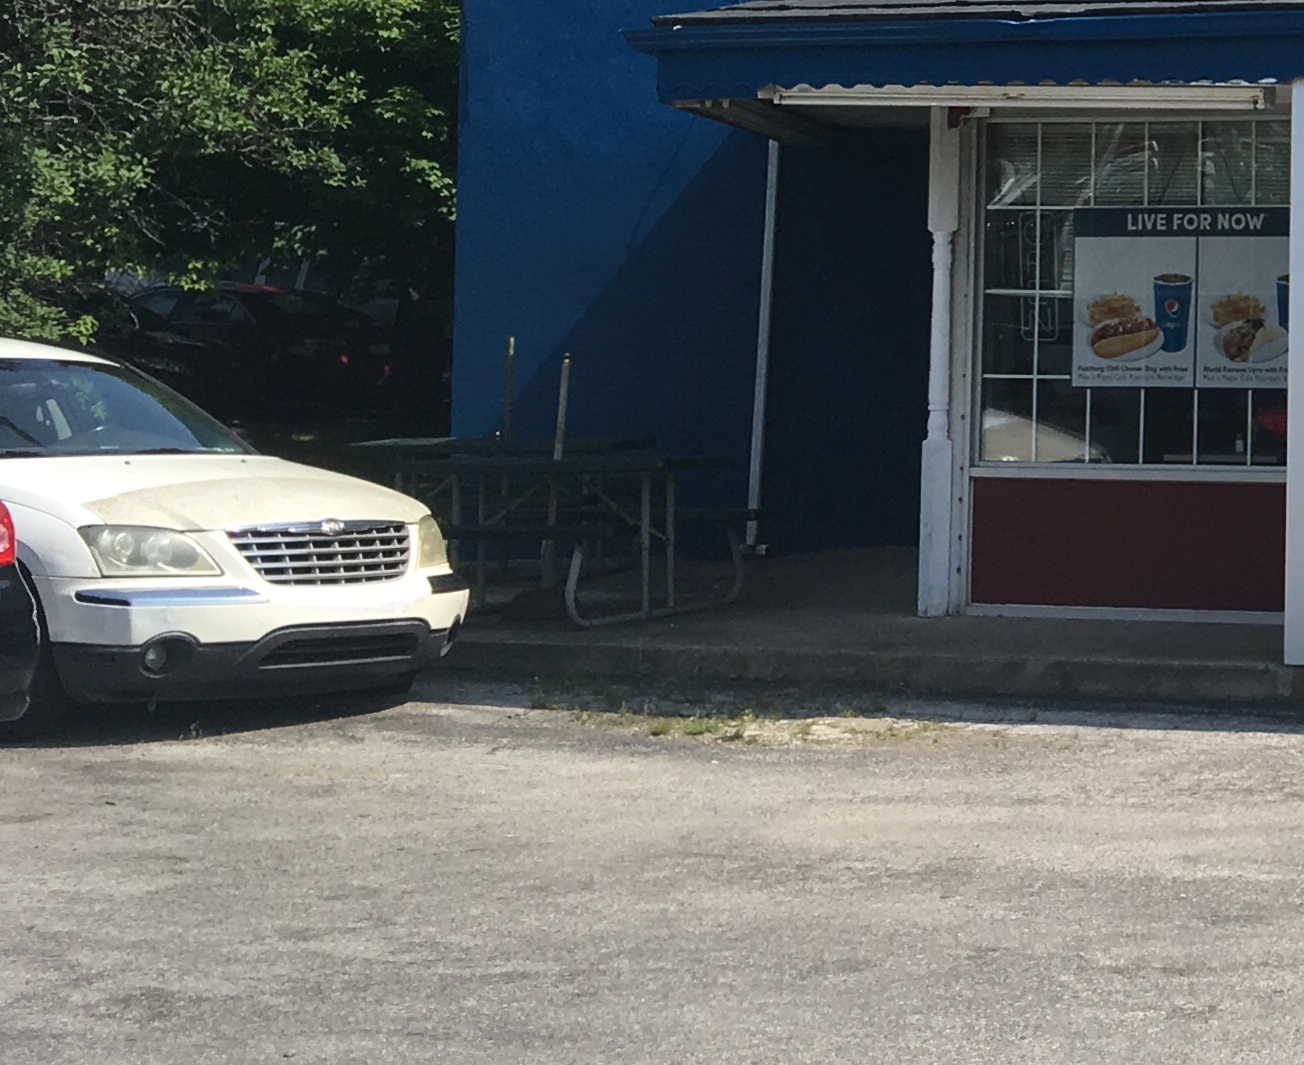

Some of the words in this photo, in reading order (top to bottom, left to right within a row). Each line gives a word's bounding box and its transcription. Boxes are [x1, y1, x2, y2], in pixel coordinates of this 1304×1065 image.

[1127, 213, 1167, 231] LIVE
[1173, 213, 1211, 230] FOR
[1217, 212, 1265, 230] NOW
